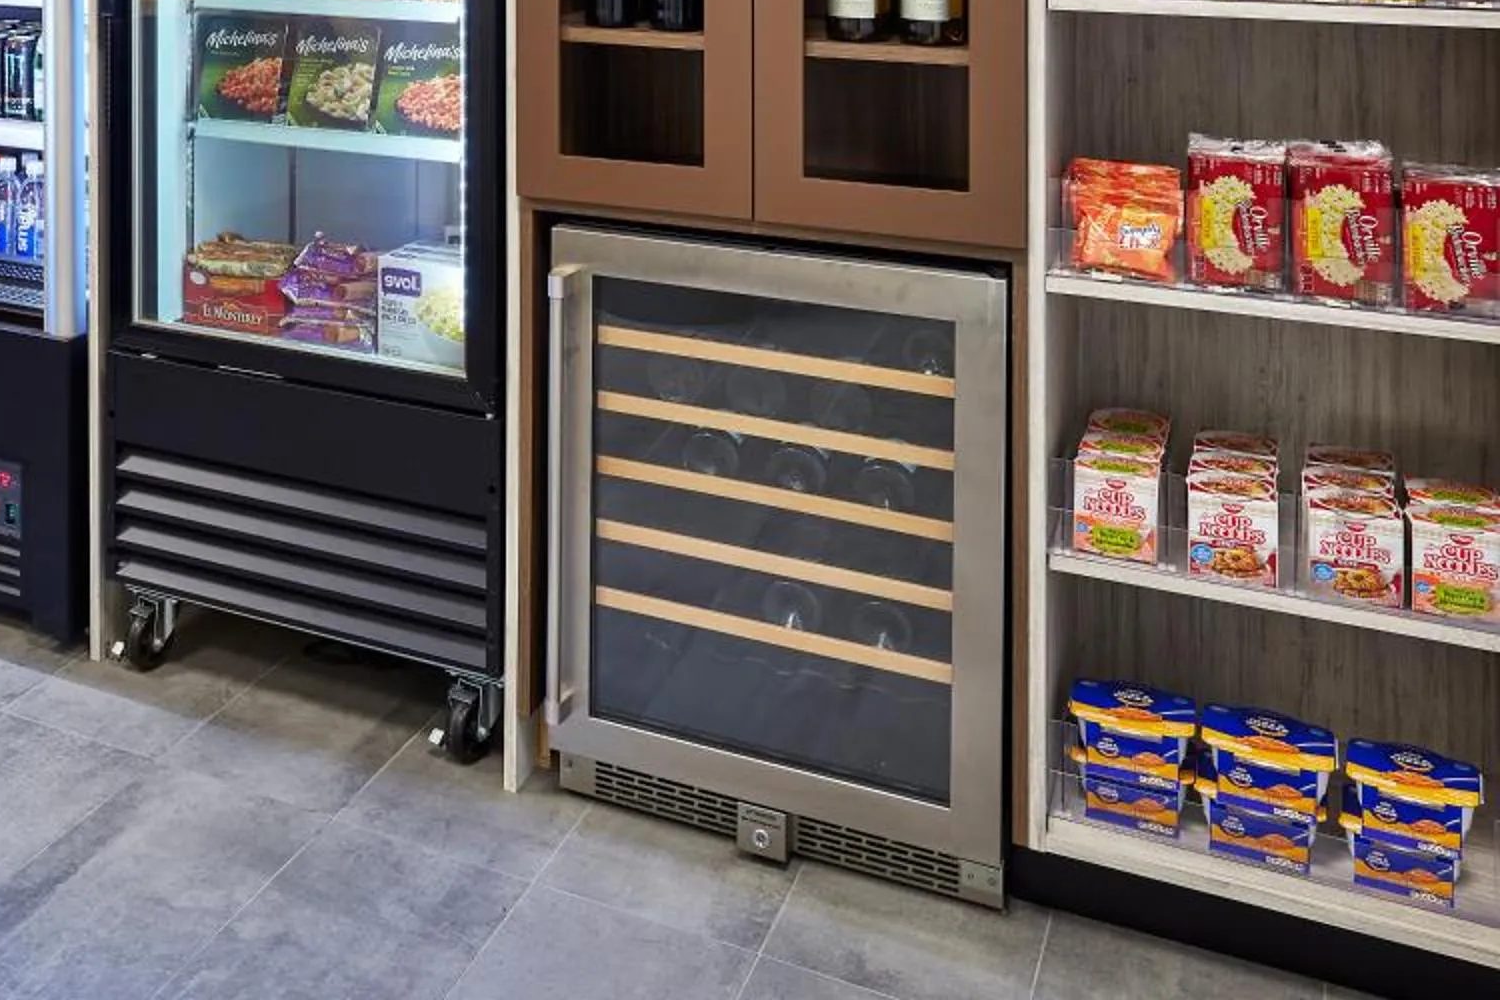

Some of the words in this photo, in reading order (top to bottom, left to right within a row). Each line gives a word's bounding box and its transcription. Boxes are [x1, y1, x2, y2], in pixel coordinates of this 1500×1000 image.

[296, 35, 369, 54] Michelina's
[1358, 215, 1380, 263] Orville
[1462, 231, 1486, 280] Orville
[1098, 488, 1133, 504] CUP
[1214, 513, 1252, 529] CUP
[1337, 530, 1377, 547] CUP
[1441, 544, 1484, 563] CUP
